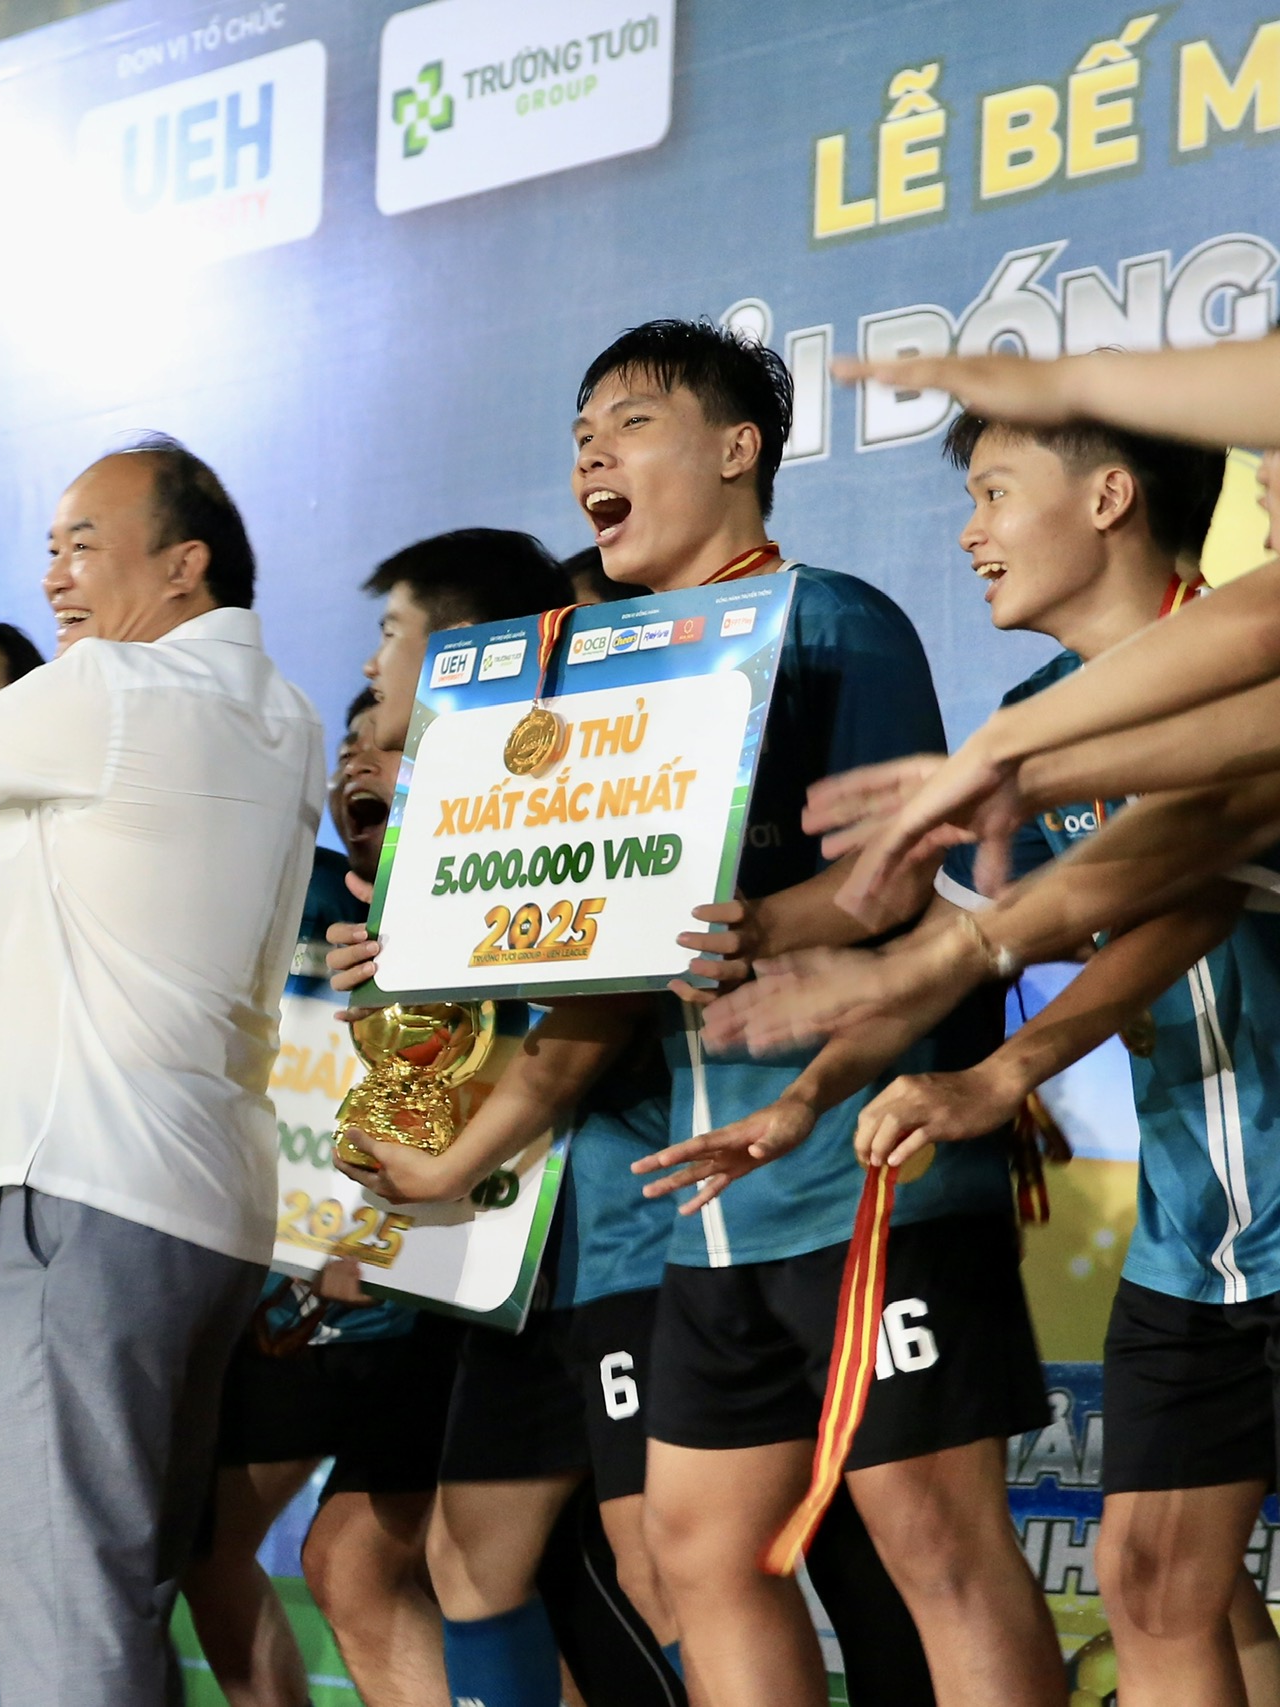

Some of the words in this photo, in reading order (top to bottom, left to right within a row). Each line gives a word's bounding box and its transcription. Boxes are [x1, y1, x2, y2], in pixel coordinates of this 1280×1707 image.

[463, 40, 582, 99] TRƯỜNG
[586, 13, 659, 64] TƯƠI
[515, 74, 598, 116] GROUP
[814, 63, 946, 238] LỄ
[980, 13, 1160, 200] BẾ
[122, 80, 274, 214] UEH
[440, 653, 468, 675] UEH
[583, 636, 607, 651] OCB
[612, 632, 638, 648] Cheers
[580, 697, 650, 758] THỦ
[433, 776, 525, 837] XUẤT
[524, 766, 594, 828] SẮC
[596, 755, 698, 819] NHẤT
[431, 841, 595, 896] 5.000.000
[603, 833, 683, 880] VNĐ
[473, 897, 607, 953] 2025
[278, 1189, 415, 1254] 2025
[600, 1350, 640, 1420] 6
